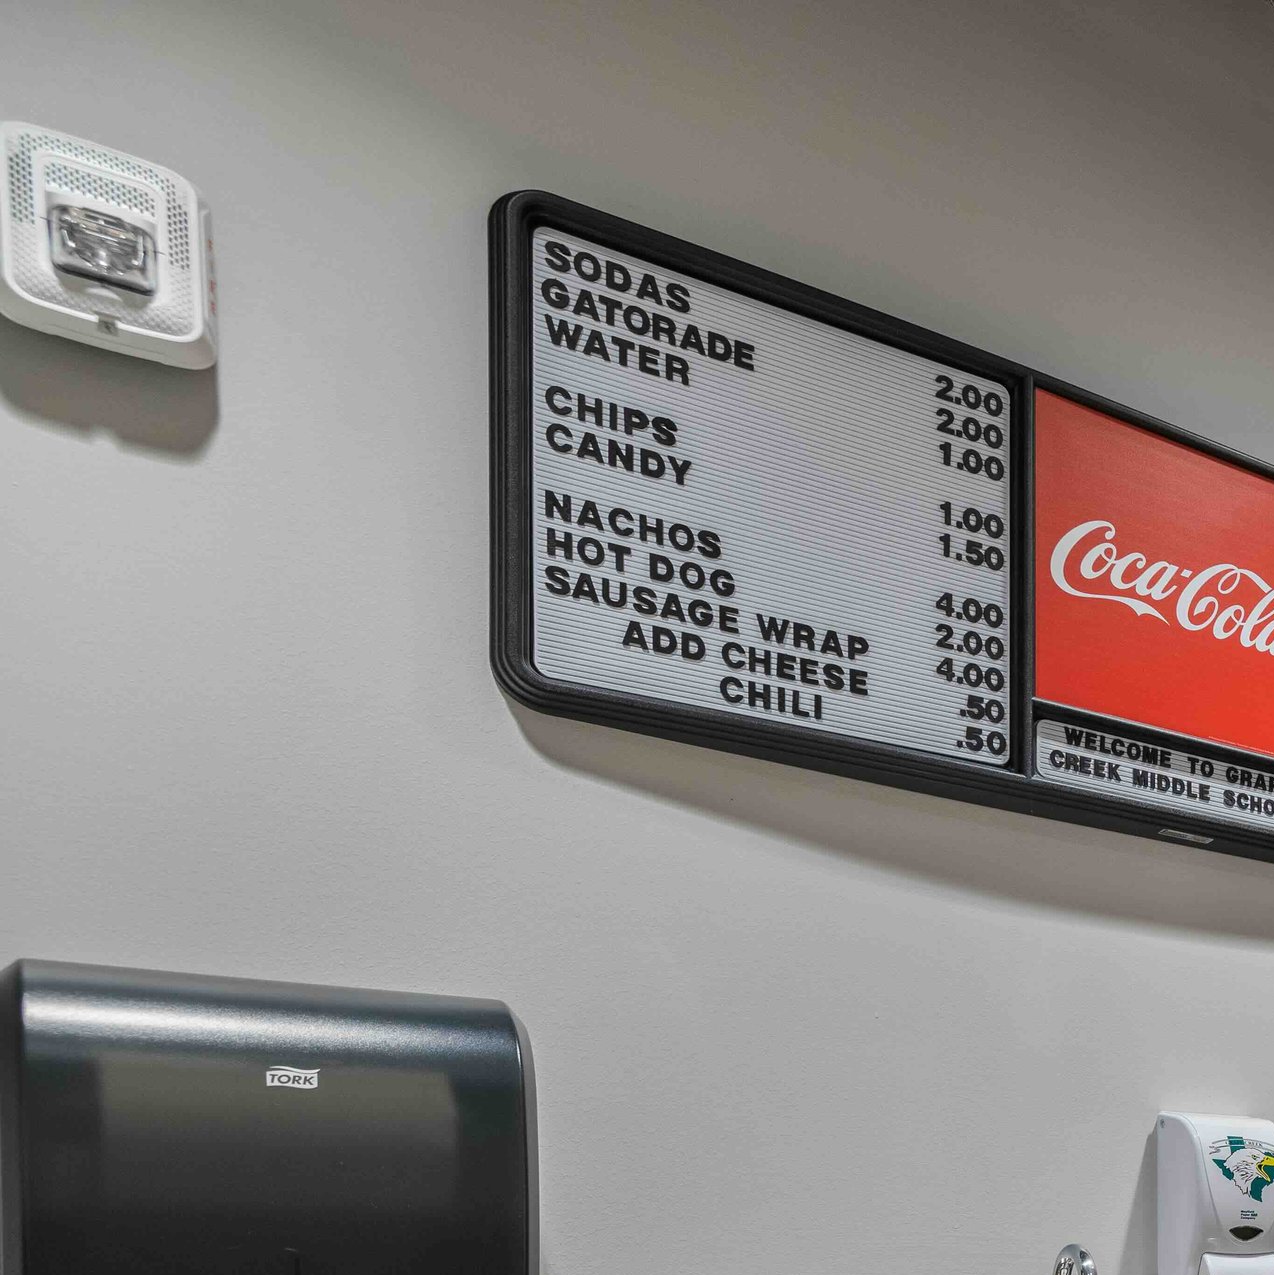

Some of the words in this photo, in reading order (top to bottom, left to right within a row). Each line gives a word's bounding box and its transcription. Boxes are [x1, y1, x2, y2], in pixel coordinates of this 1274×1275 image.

[541, 278, 755, 371] GATORADE
[936, 408, 1003, 449] 2.00
[544, 240, 691, 314] SODAS
[935, 375, 1003, 417] 2.00
[544, 313, 690, 386] WATER
[939, 441, 1004, 481] 1.00
[545, 385, 678, 448] CHIPS
[939, 501, 1004, 539] 1.00
[544, 490, 722, 559] NACHOS
[935, 592, 1004, 628] 4.00
[546, 423, 691, 486] CANDY
[939, 533, 1004, 571] 1.50
[545, 565, 740, 634] SAUSAGE
[755, 613, 870, 660] WRAP
[936, 657, 1005, 692] 4.00
[546, 527, 631, 573] HOT
[648, 552, 736, 597] DOG
[935, 623, 1004, 660] 2.00
[621, 620, 706, 661] ADD
[721, 641, 869, 696] CHEESE
[960, 694, 1005, 724] .50
[719, 676, 822, 720] CHILI
[956, 725, 1007, 756] .50
[1050, 749, 1122, 782] CREEK
[1132, 768, 1211, 801] MIDDLE
[1064, 726, 1172, 769] WELCOME
[1187, 756, 1215, 778] TO
[269, 1074, 314, 1085] TORK
